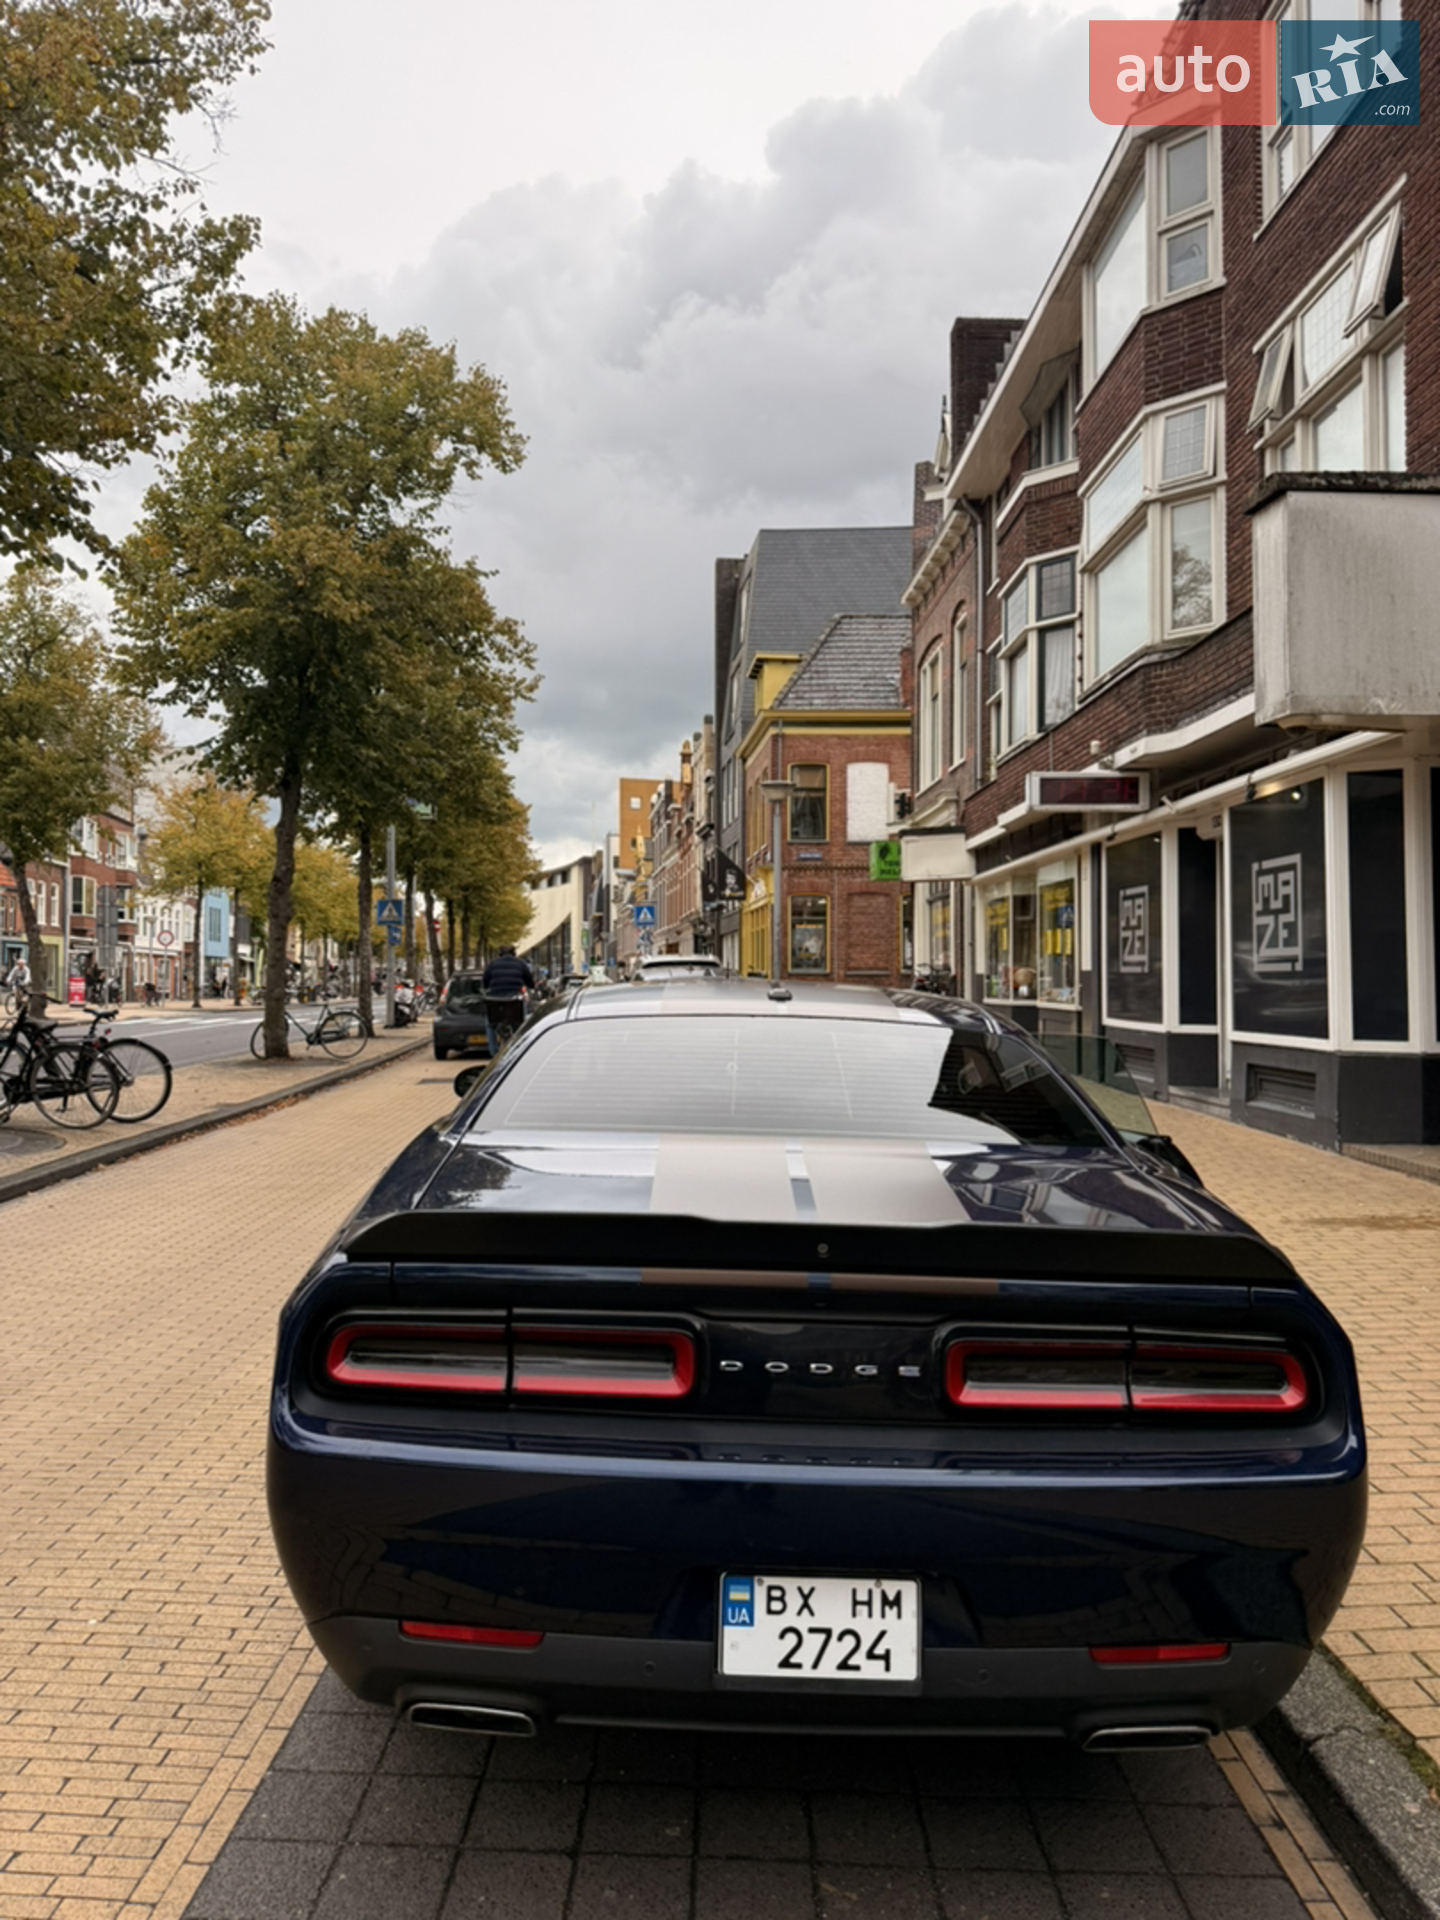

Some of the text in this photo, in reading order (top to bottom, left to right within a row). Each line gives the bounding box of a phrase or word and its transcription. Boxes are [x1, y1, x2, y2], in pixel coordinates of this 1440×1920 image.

[719, 1359, 922, 1378] DODGE
[727, 1607, 751, 1624] UA
[766, 1584, 903, 1620] BX HM
[777, 1626, 892, 1673] 2724
